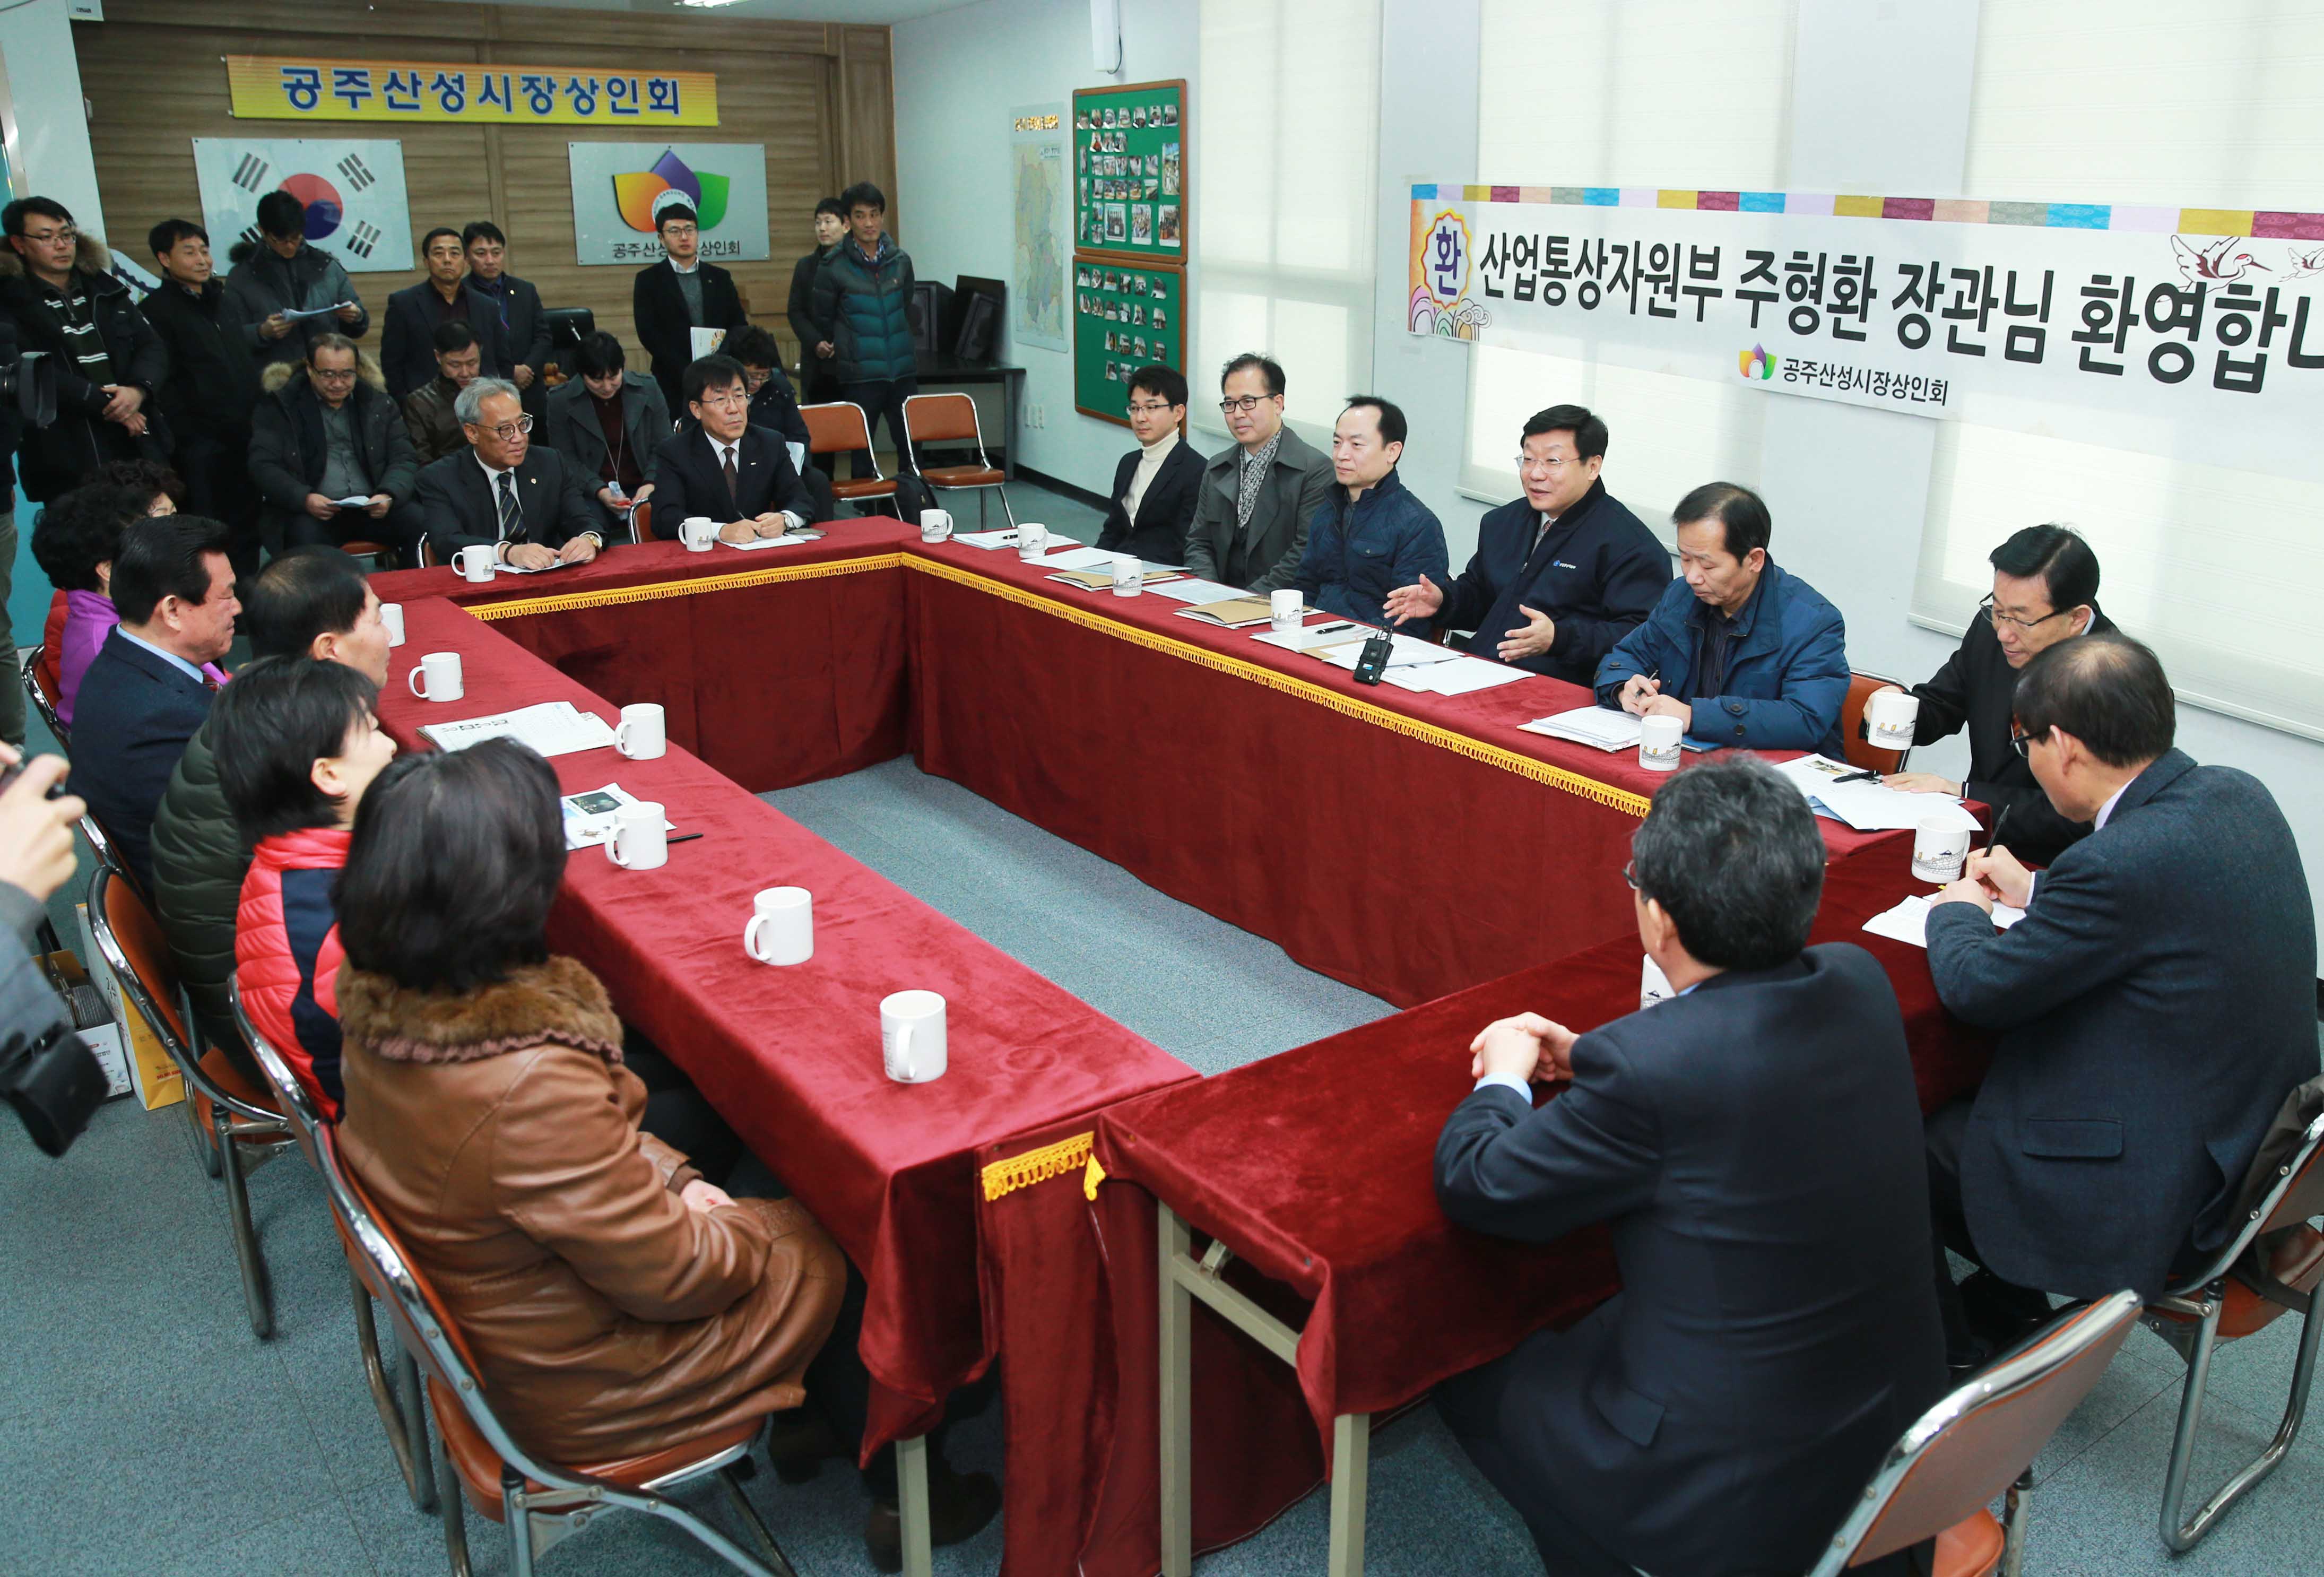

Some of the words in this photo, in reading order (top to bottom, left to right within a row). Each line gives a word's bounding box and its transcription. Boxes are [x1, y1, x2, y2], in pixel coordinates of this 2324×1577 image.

[281, 67, 680, 115] 공주산성시장상인회
[612, 240, 740, 259] 공주산상인회
[1434, 226, 1461, 296] 환
[1479, 232, 1723, 322] 산업통상자원부
[1735, 250, 1877, 342] 주형환
[1892, 261, 2054, 364] 장관님
[1783, 358, 1949, 406] 공주산성시장상인회
